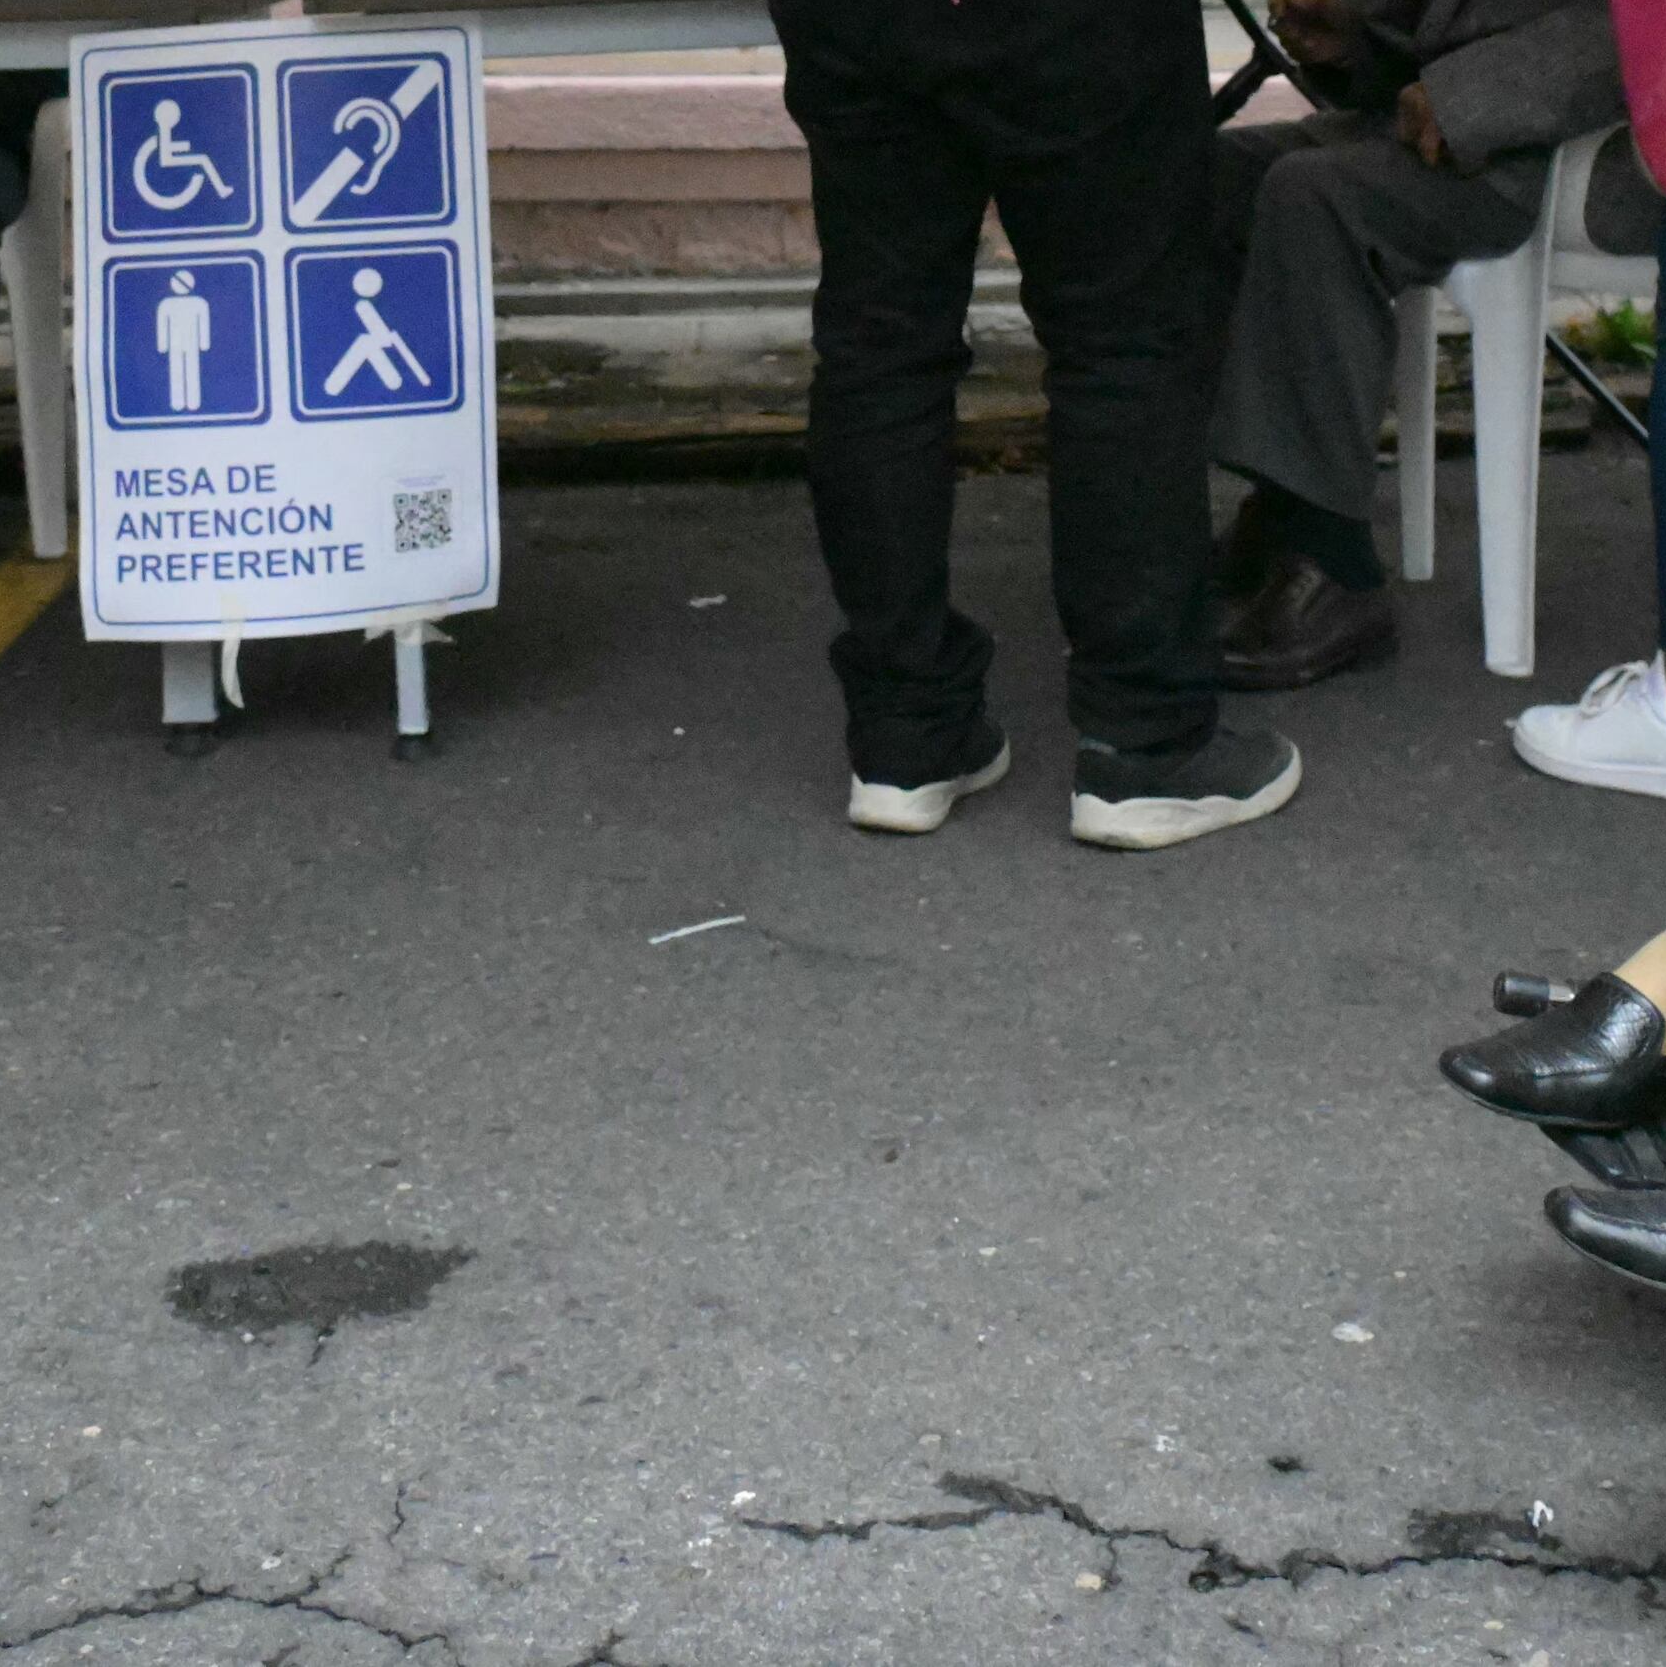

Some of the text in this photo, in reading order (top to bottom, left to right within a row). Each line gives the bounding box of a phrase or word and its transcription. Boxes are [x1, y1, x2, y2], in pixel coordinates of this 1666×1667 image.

[114, 464, 277, 498] MESA DE
[115, 497, 334, 541] ANTENCIÓN
[117, 543, 366, 584] PREFERENTE
